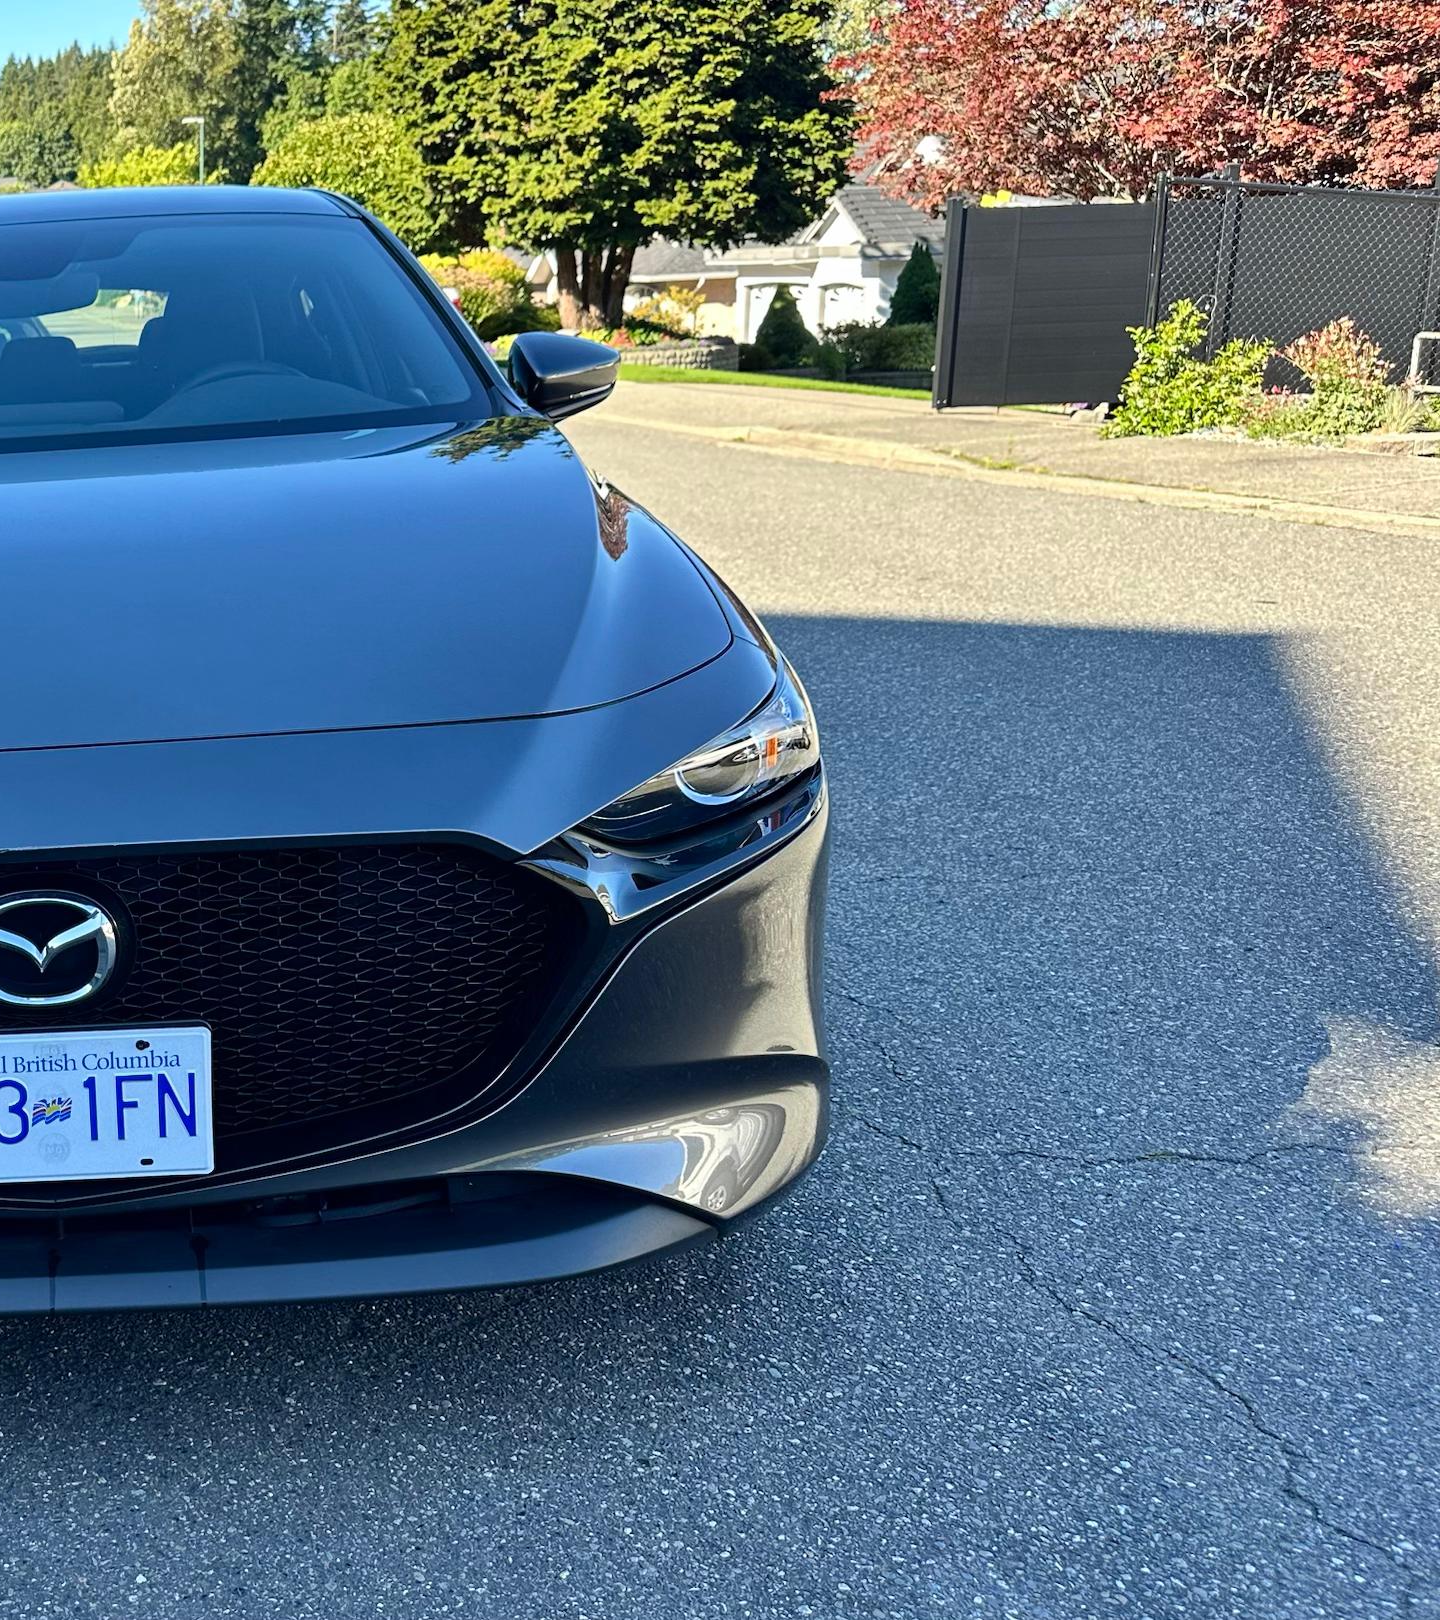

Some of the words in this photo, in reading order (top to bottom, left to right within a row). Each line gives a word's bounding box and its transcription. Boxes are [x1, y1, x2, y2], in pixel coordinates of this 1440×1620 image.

[12, 1053, 78, 1073] British
[81, 1050, 182, 1070] Columbia
[83, 1072, 197, 1141] 1FN
